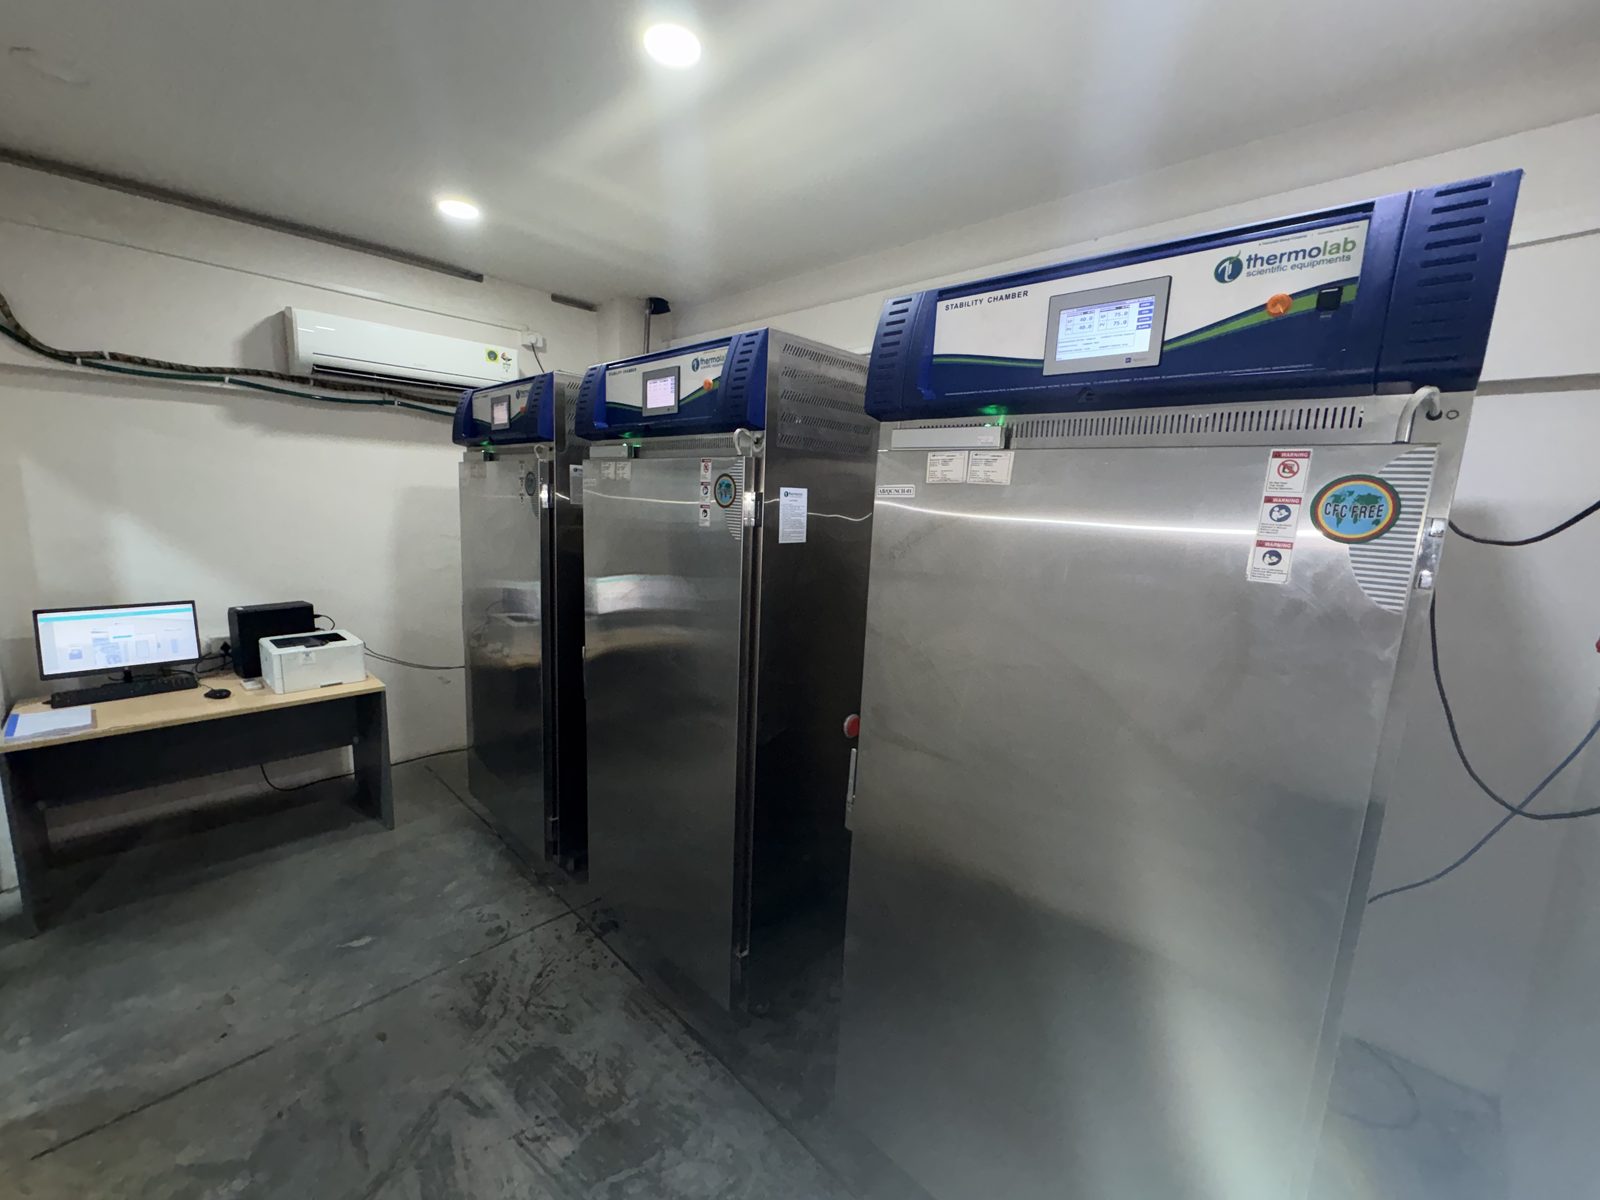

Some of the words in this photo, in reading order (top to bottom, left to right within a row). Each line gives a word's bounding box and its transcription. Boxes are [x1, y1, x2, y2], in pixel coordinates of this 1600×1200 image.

[1246, 237, 1356, 269] thermolab
[1246, 264, 1288, 277] scientific
[1290, 254, 1351, 271] equipments
[944, 298, 984, 311] STABILITY
[987, 290, 1029, 304] CHAMBER
[1324, 502, 1348, 518] CFC
[1351, 503, 1385, 519] FREE
